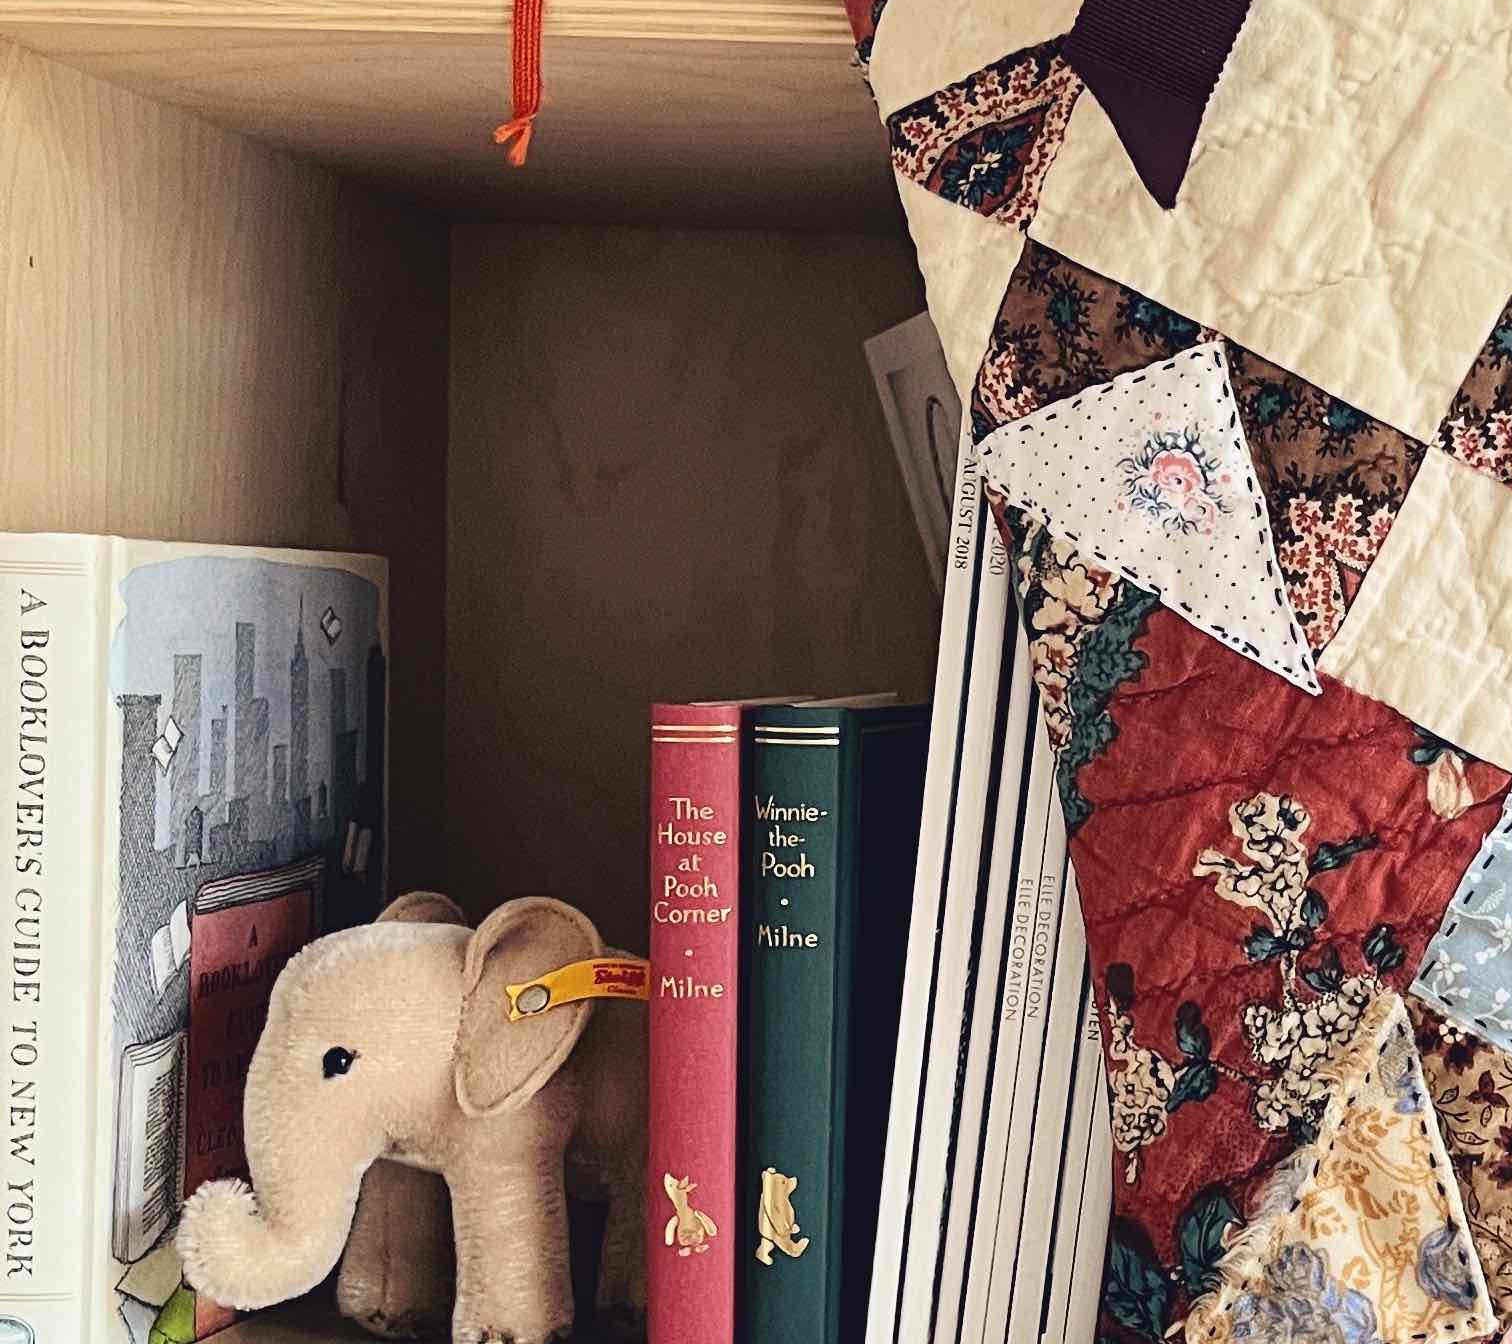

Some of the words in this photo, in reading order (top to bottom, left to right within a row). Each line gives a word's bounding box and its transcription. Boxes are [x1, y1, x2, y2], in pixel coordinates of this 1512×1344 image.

[20, 588, 48, 616] A
[669, 797, 715, 820] The
[755, 794, 828, 822] Winnie-
[658, 823, 727, 845] House
[769, 825, 805, 848] the-
[678, 855, 702, 872] at
[762, 852, 815, 878] Pooh
[664, 876, 718, 898] Pooh
[654, 901, 732, 923] Corner
[13, 887, 43, 1002] GUIDE
[758, 924, 818, 948] Milne
[1005, 914, 1030, 1021] DECORATION
[1027, 911, 1051, 1019] DECORATION
[660, 975, 724, 999] Milne
[12, 1017, 39, 1066] TO
[9, 1080, 38, 1167] NEW
[6, 1177, 35, 1278] YORK
